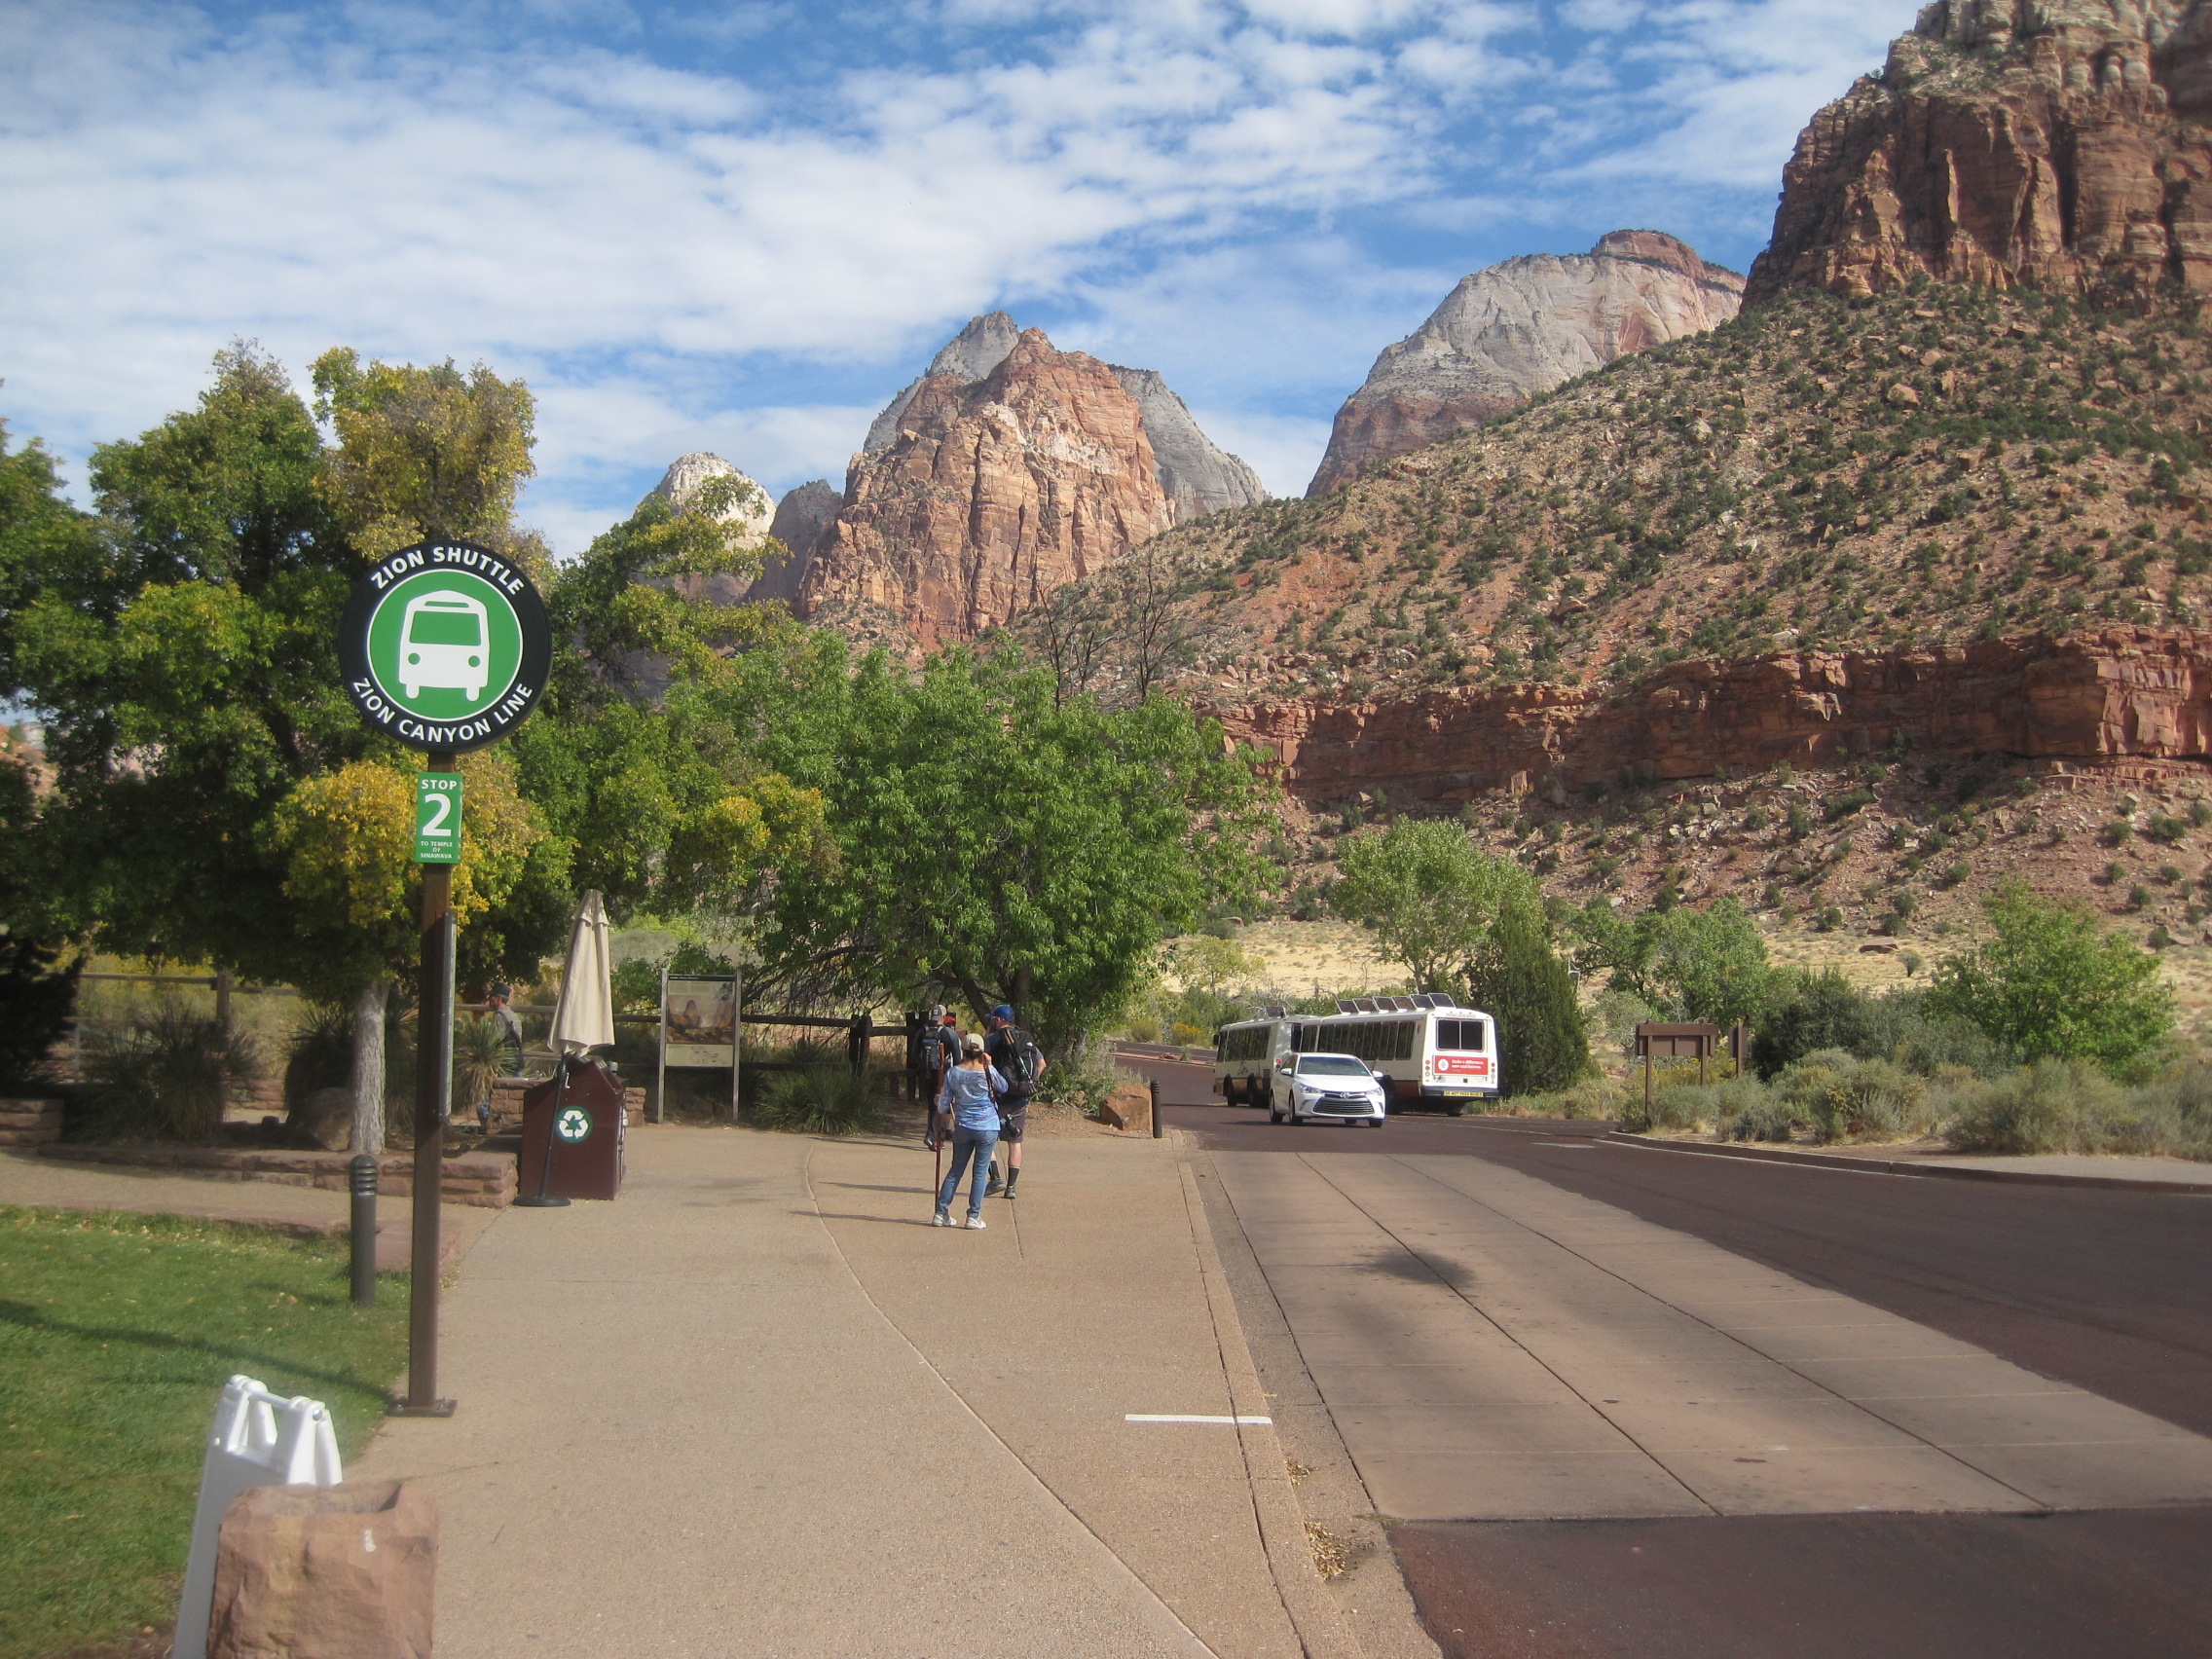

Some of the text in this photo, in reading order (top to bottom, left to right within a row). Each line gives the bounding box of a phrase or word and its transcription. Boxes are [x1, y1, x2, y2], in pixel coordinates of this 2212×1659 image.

[370, 546, 525, 596] ZION SHUTTLE
[352, 677, 534, 743] ZION CANYON LINE
[422, 779, 458, 791] STOP
[422, 793, 452, 836] 2
